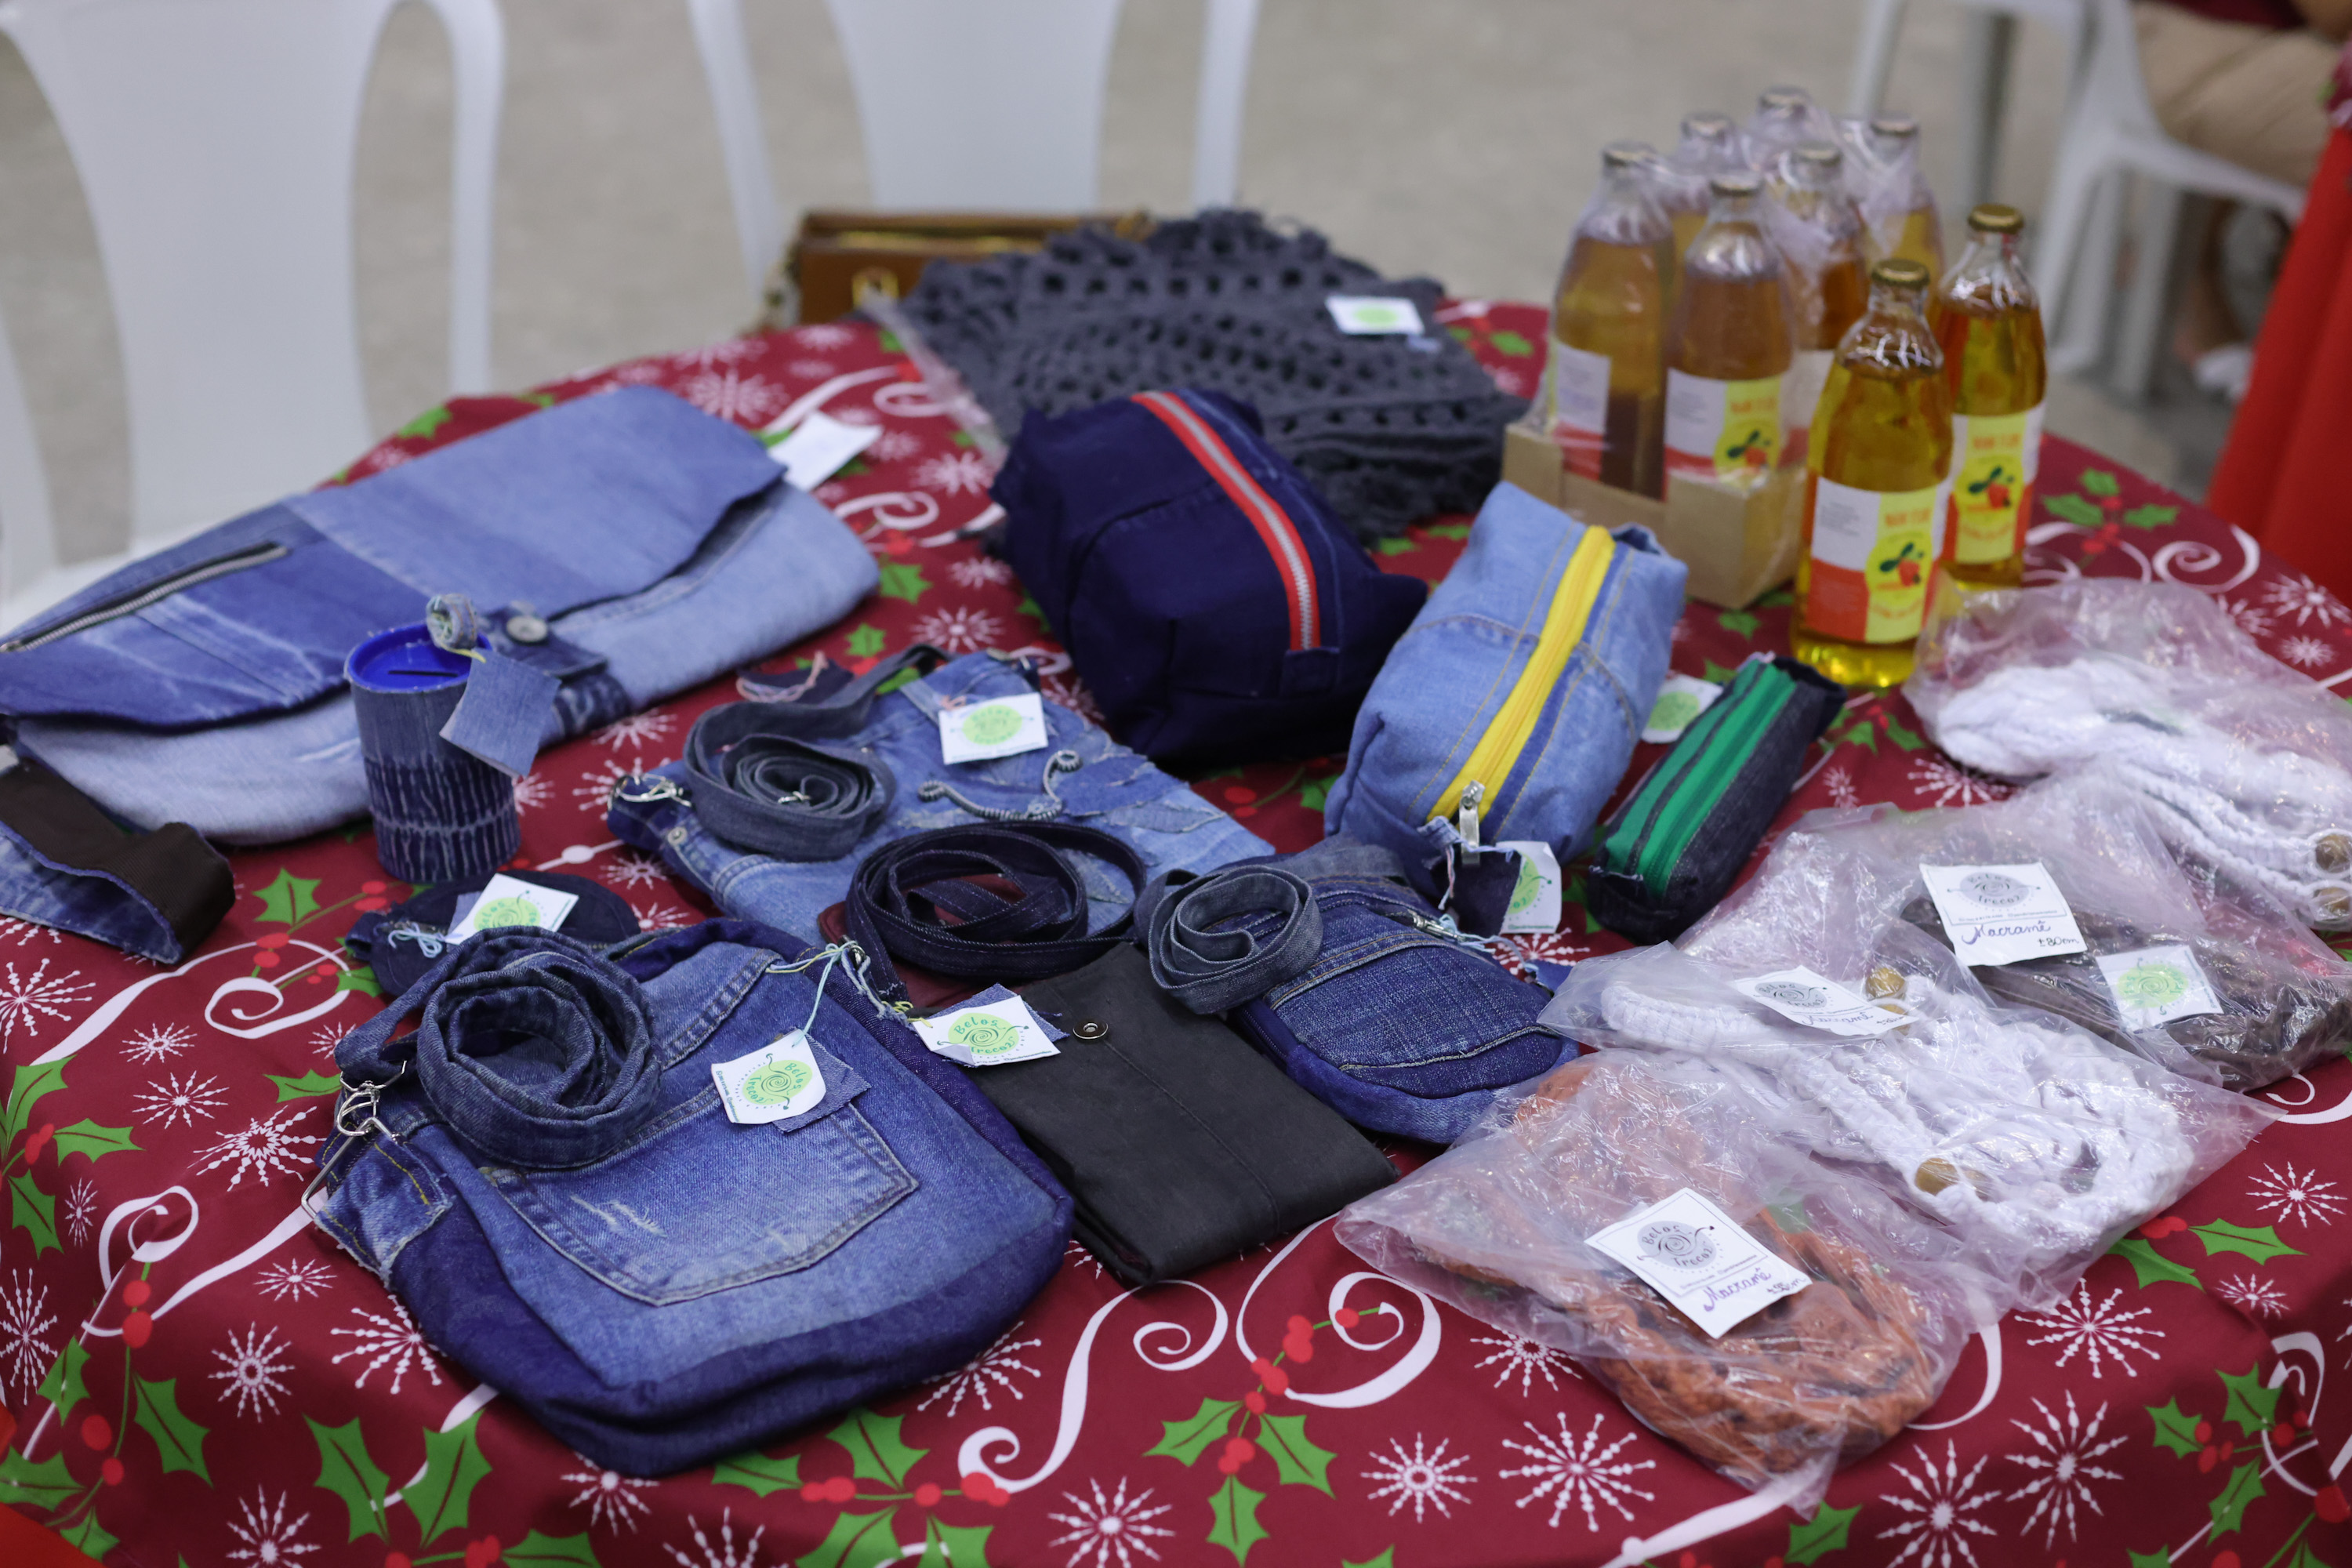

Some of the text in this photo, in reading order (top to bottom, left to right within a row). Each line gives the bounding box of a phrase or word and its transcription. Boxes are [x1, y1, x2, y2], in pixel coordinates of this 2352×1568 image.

[953, 1016, 1007, 1035] Belos
[784, 1062, 807, 1095] Belos
[1641, 1225, 1693, 1246] Belos
